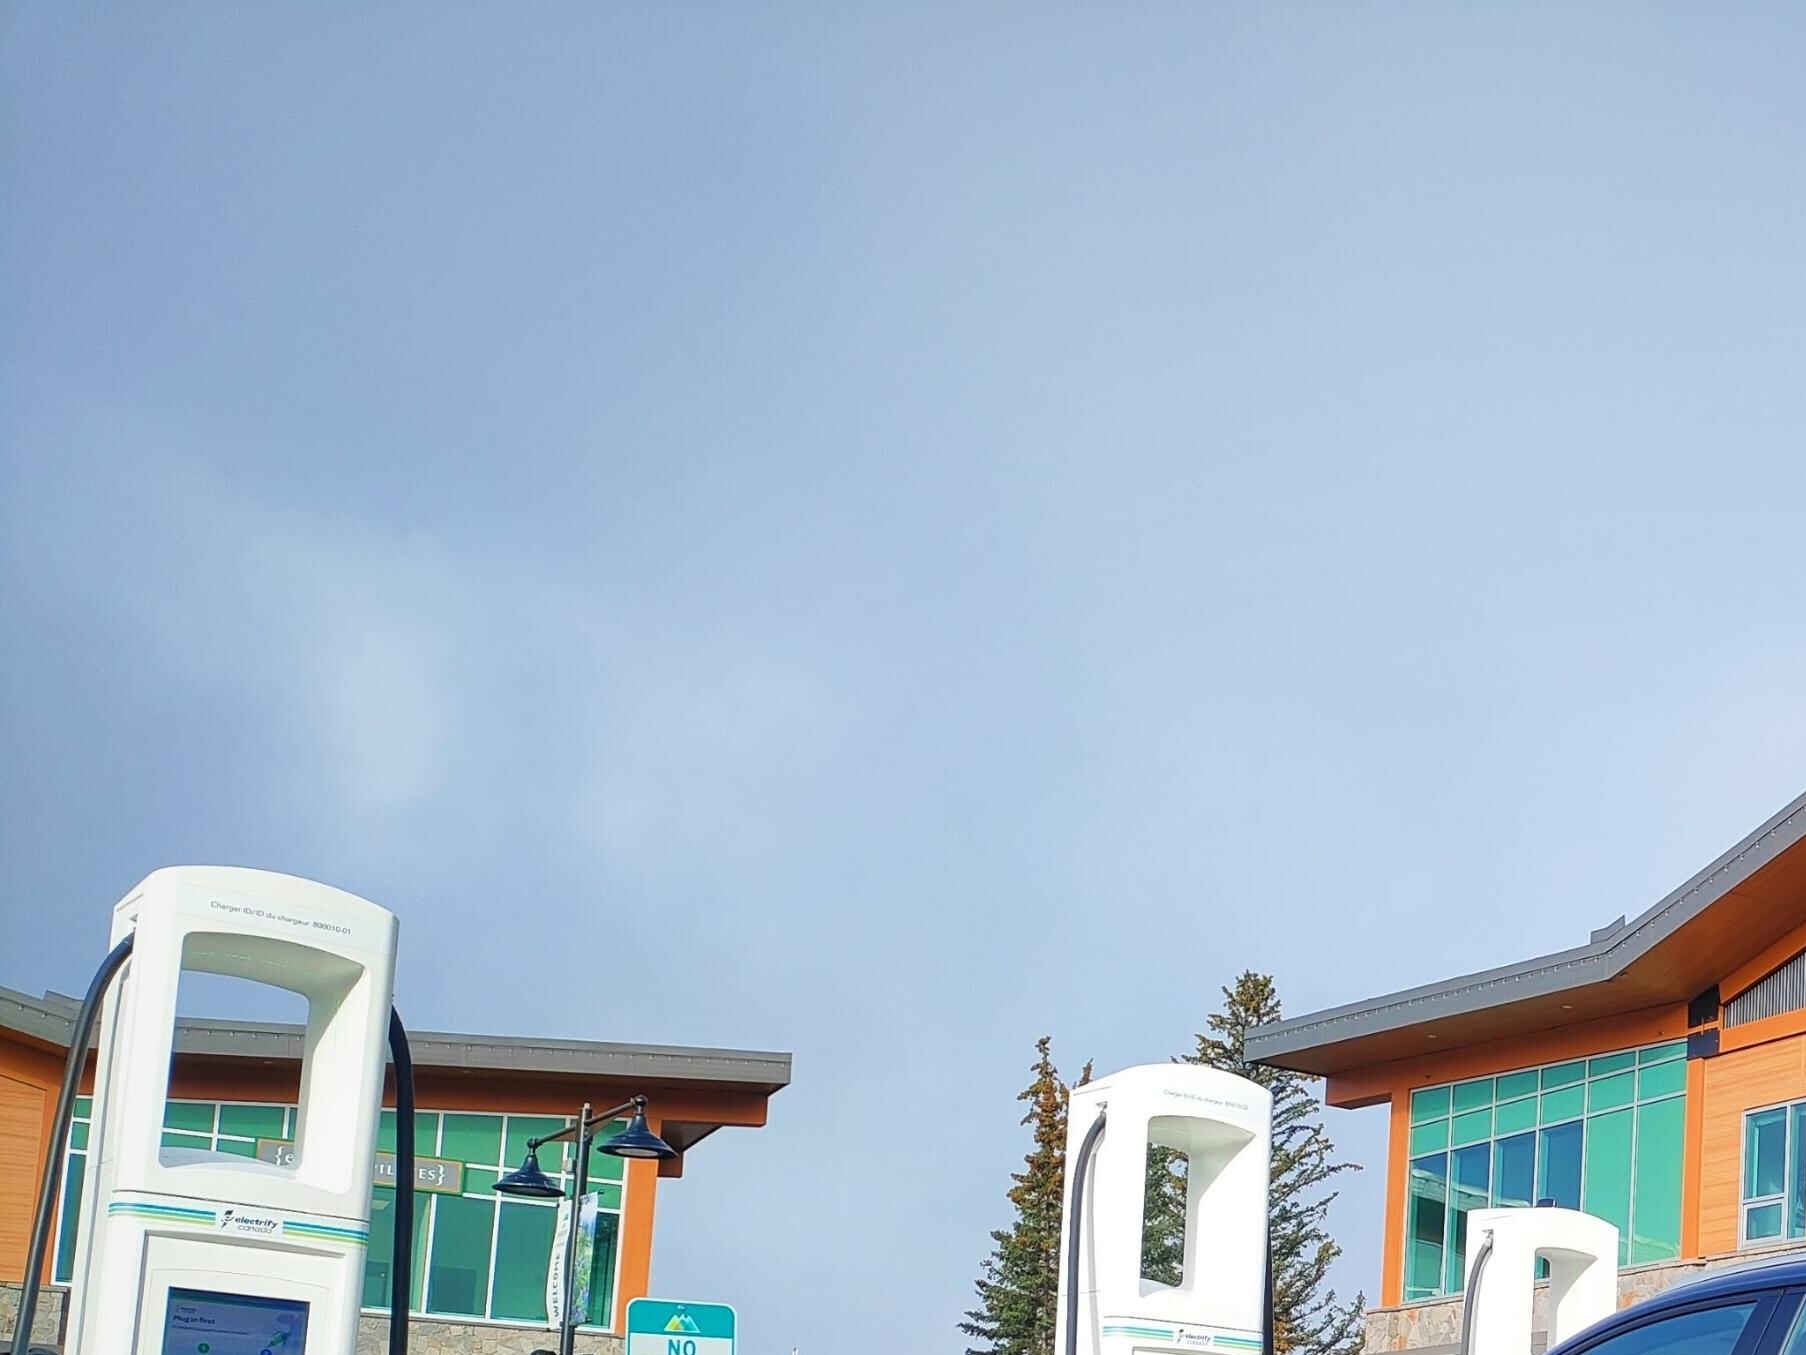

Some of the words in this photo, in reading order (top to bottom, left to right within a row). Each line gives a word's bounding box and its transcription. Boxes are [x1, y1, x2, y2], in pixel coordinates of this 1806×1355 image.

[235, 1216, 278, 1229] electrify
[238, 1224, 272, 1234] canada
[550, 1255, 561, 1318] WELCOME
